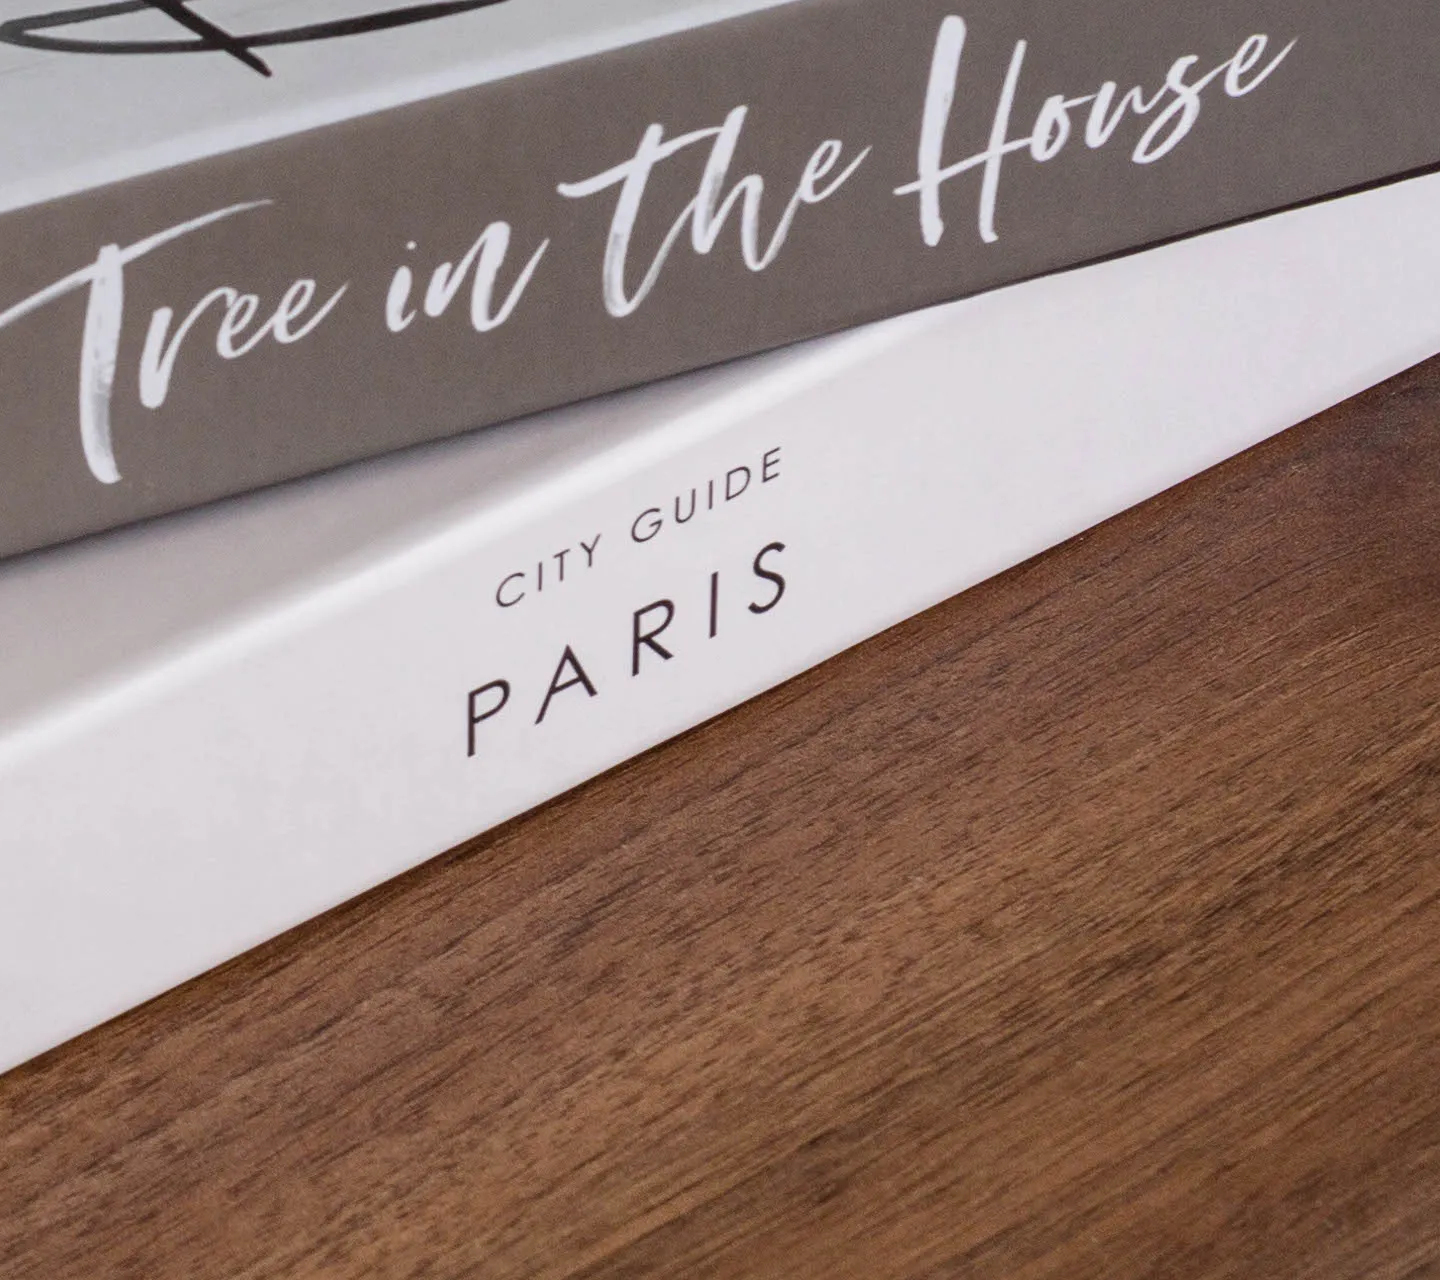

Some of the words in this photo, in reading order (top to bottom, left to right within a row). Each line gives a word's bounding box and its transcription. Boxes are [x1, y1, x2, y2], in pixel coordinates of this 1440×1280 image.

[383, 220, 550, 333] in
[555, 104, 873, 317] the
[892, 14, 1300, 247] House
[494, 532, 602, 609] CITY
[630, 446, 783, 544] GUIDE
[466, 540, 787, 758] PARIS
